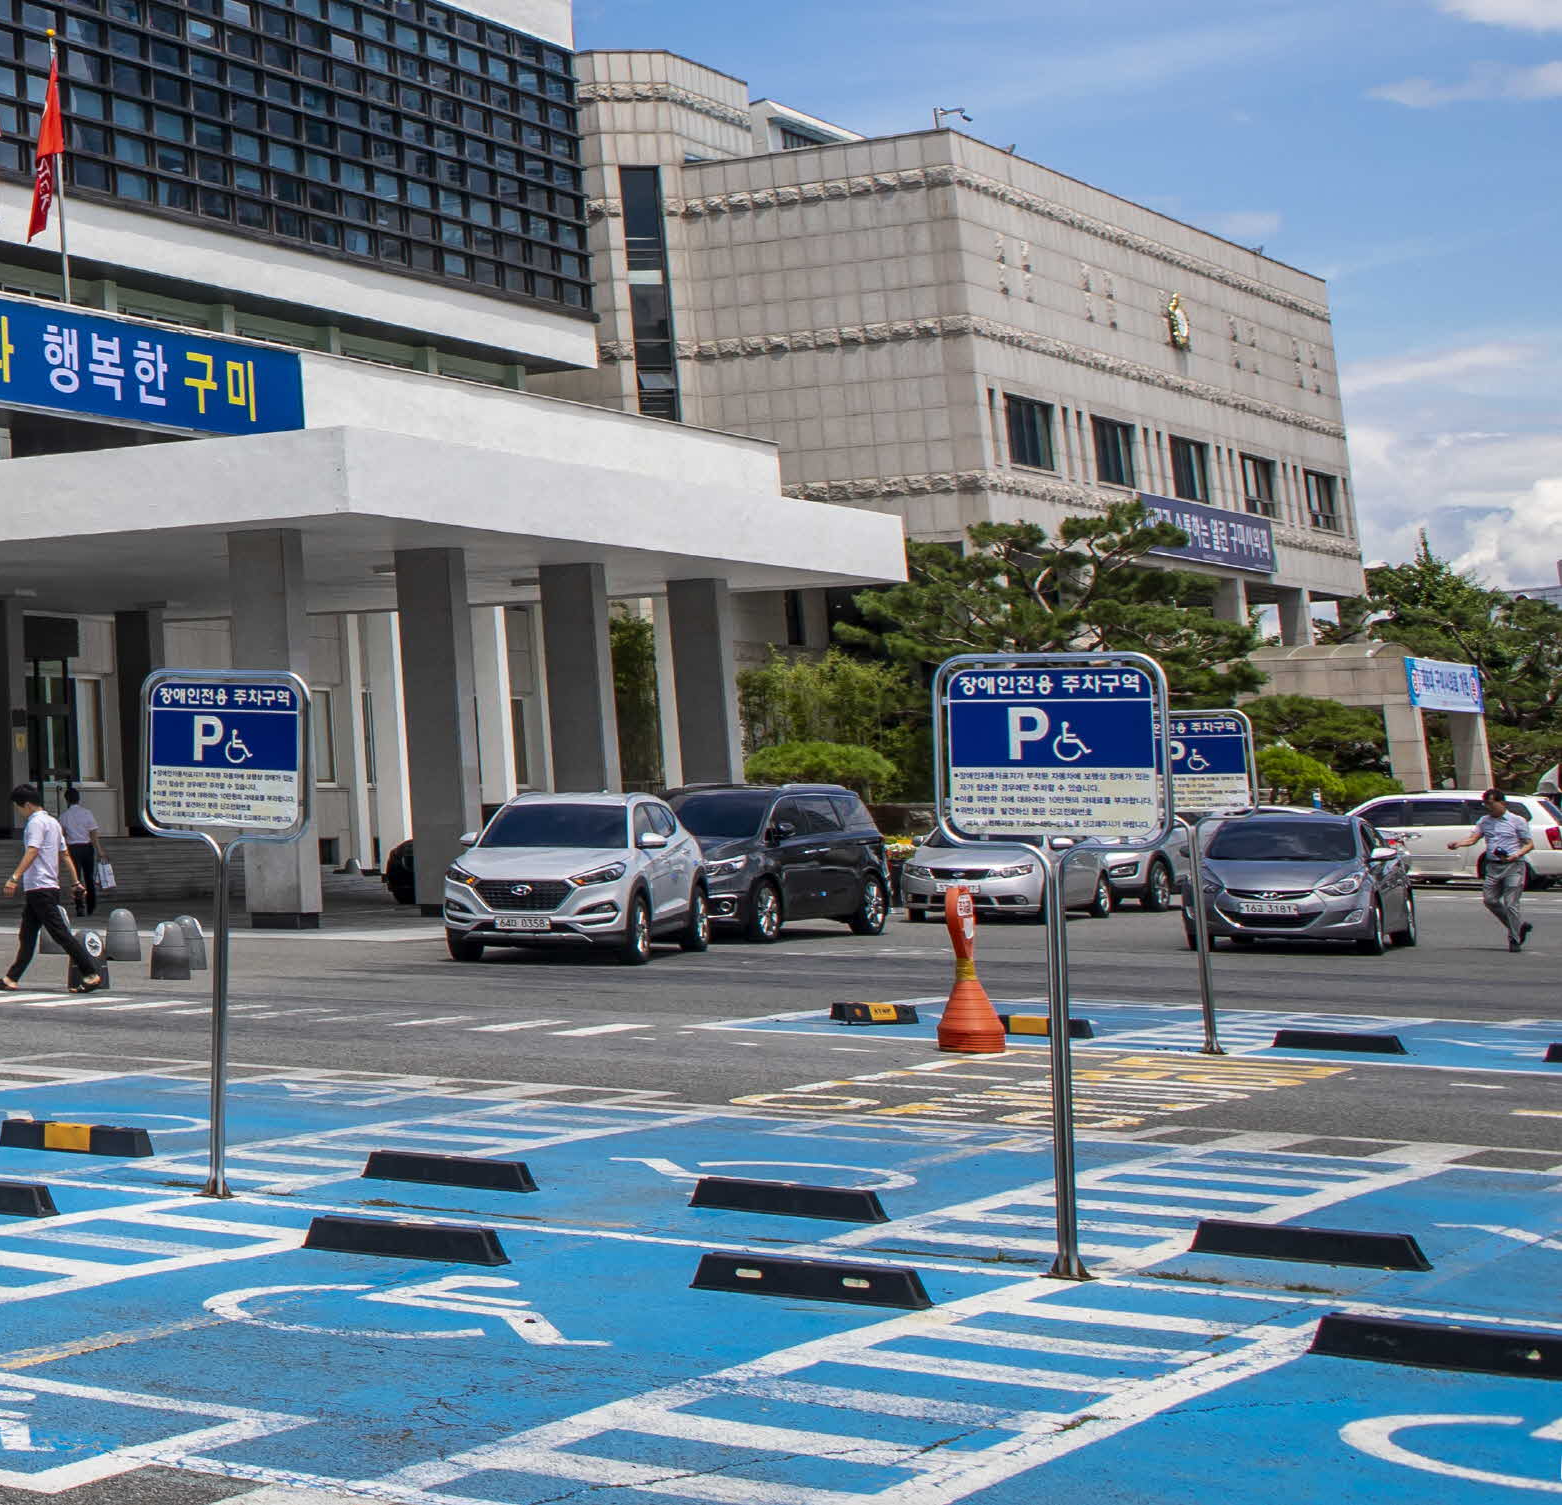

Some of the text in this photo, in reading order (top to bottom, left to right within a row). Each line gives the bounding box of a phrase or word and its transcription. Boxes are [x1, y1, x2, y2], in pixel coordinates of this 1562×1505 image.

[43, 324, 168, 407] 행복한
[184, 352, 257, 422] 구미
[160, 687, 290, 706] 장애인전용 주차구역
[959, 673, 1141, 695] 장애인전용 주차구역
[193, 715, 224, 761] P
[1007, 706, 1049, 760] P
[1191, 721, 1237, 732] 주차구역
